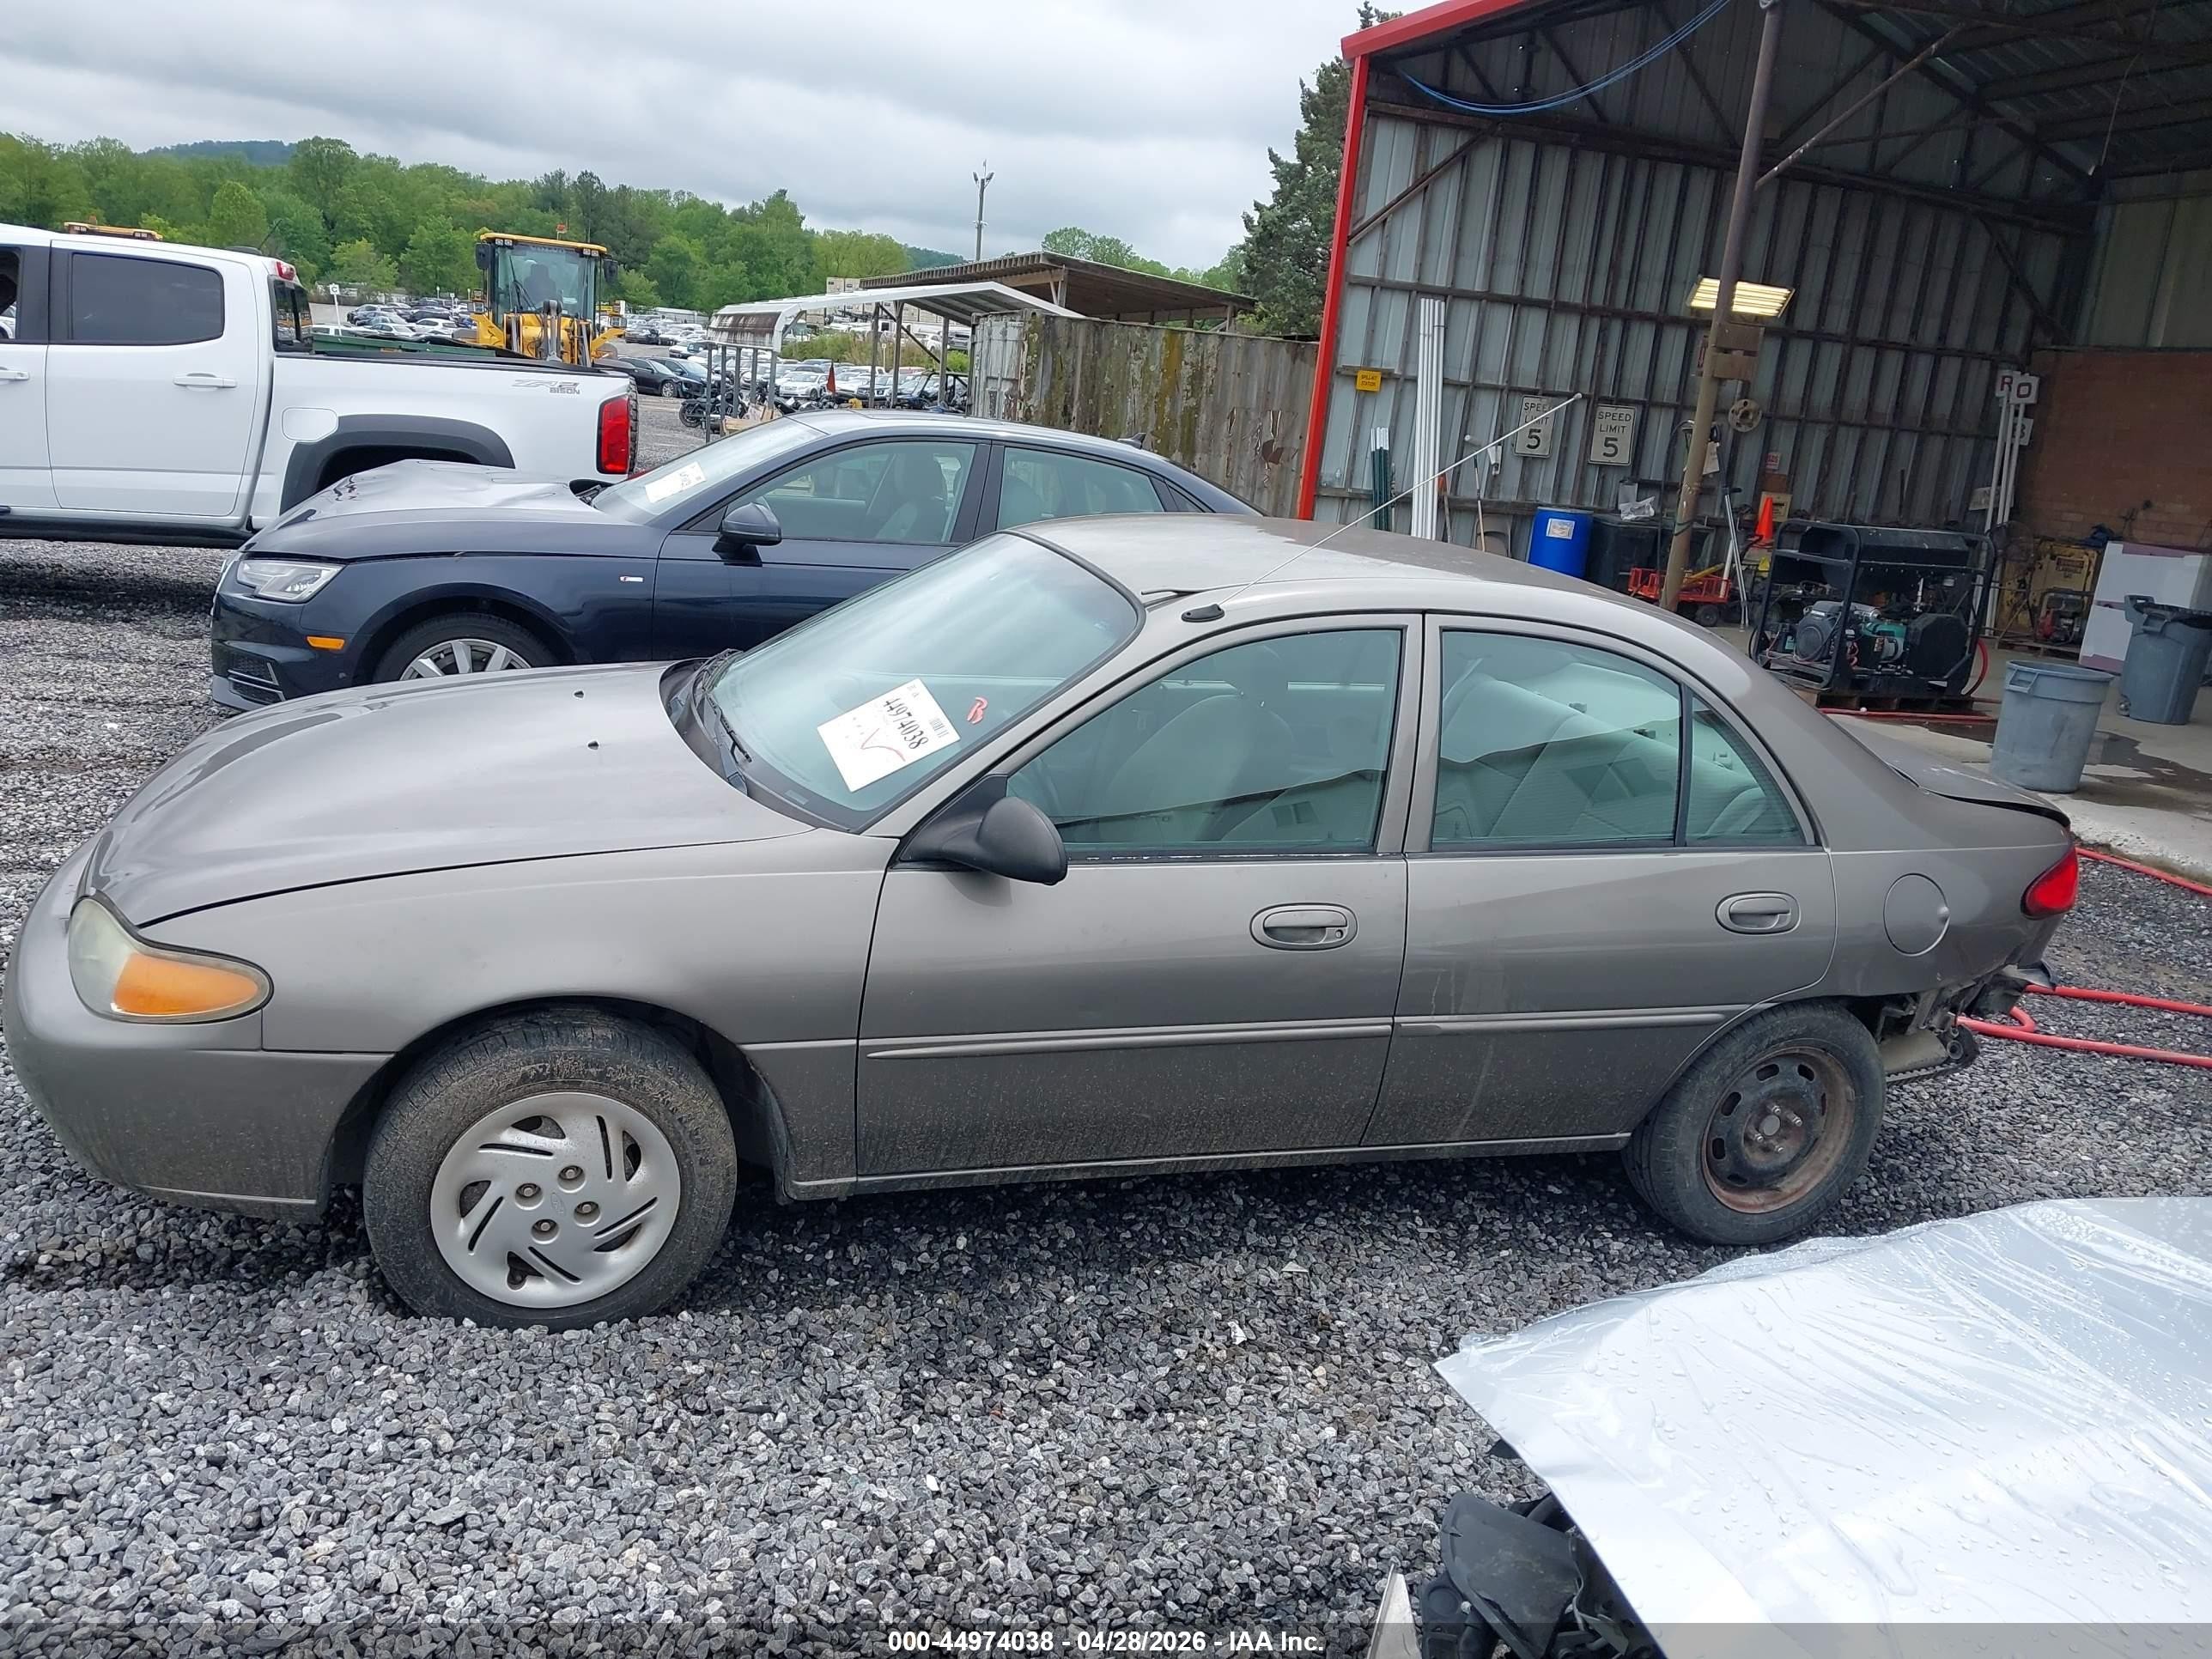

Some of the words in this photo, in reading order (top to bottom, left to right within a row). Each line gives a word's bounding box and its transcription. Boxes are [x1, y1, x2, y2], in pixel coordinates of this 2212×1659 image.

[1598, 411, 1632, 422] SPEED
[1527, 428, 1541, 449] 5
[1600, 424, 1627, 434] LIMIT
[1603, 437, 1619, 458] 5
[883, 697, 928, 750] 44974038
